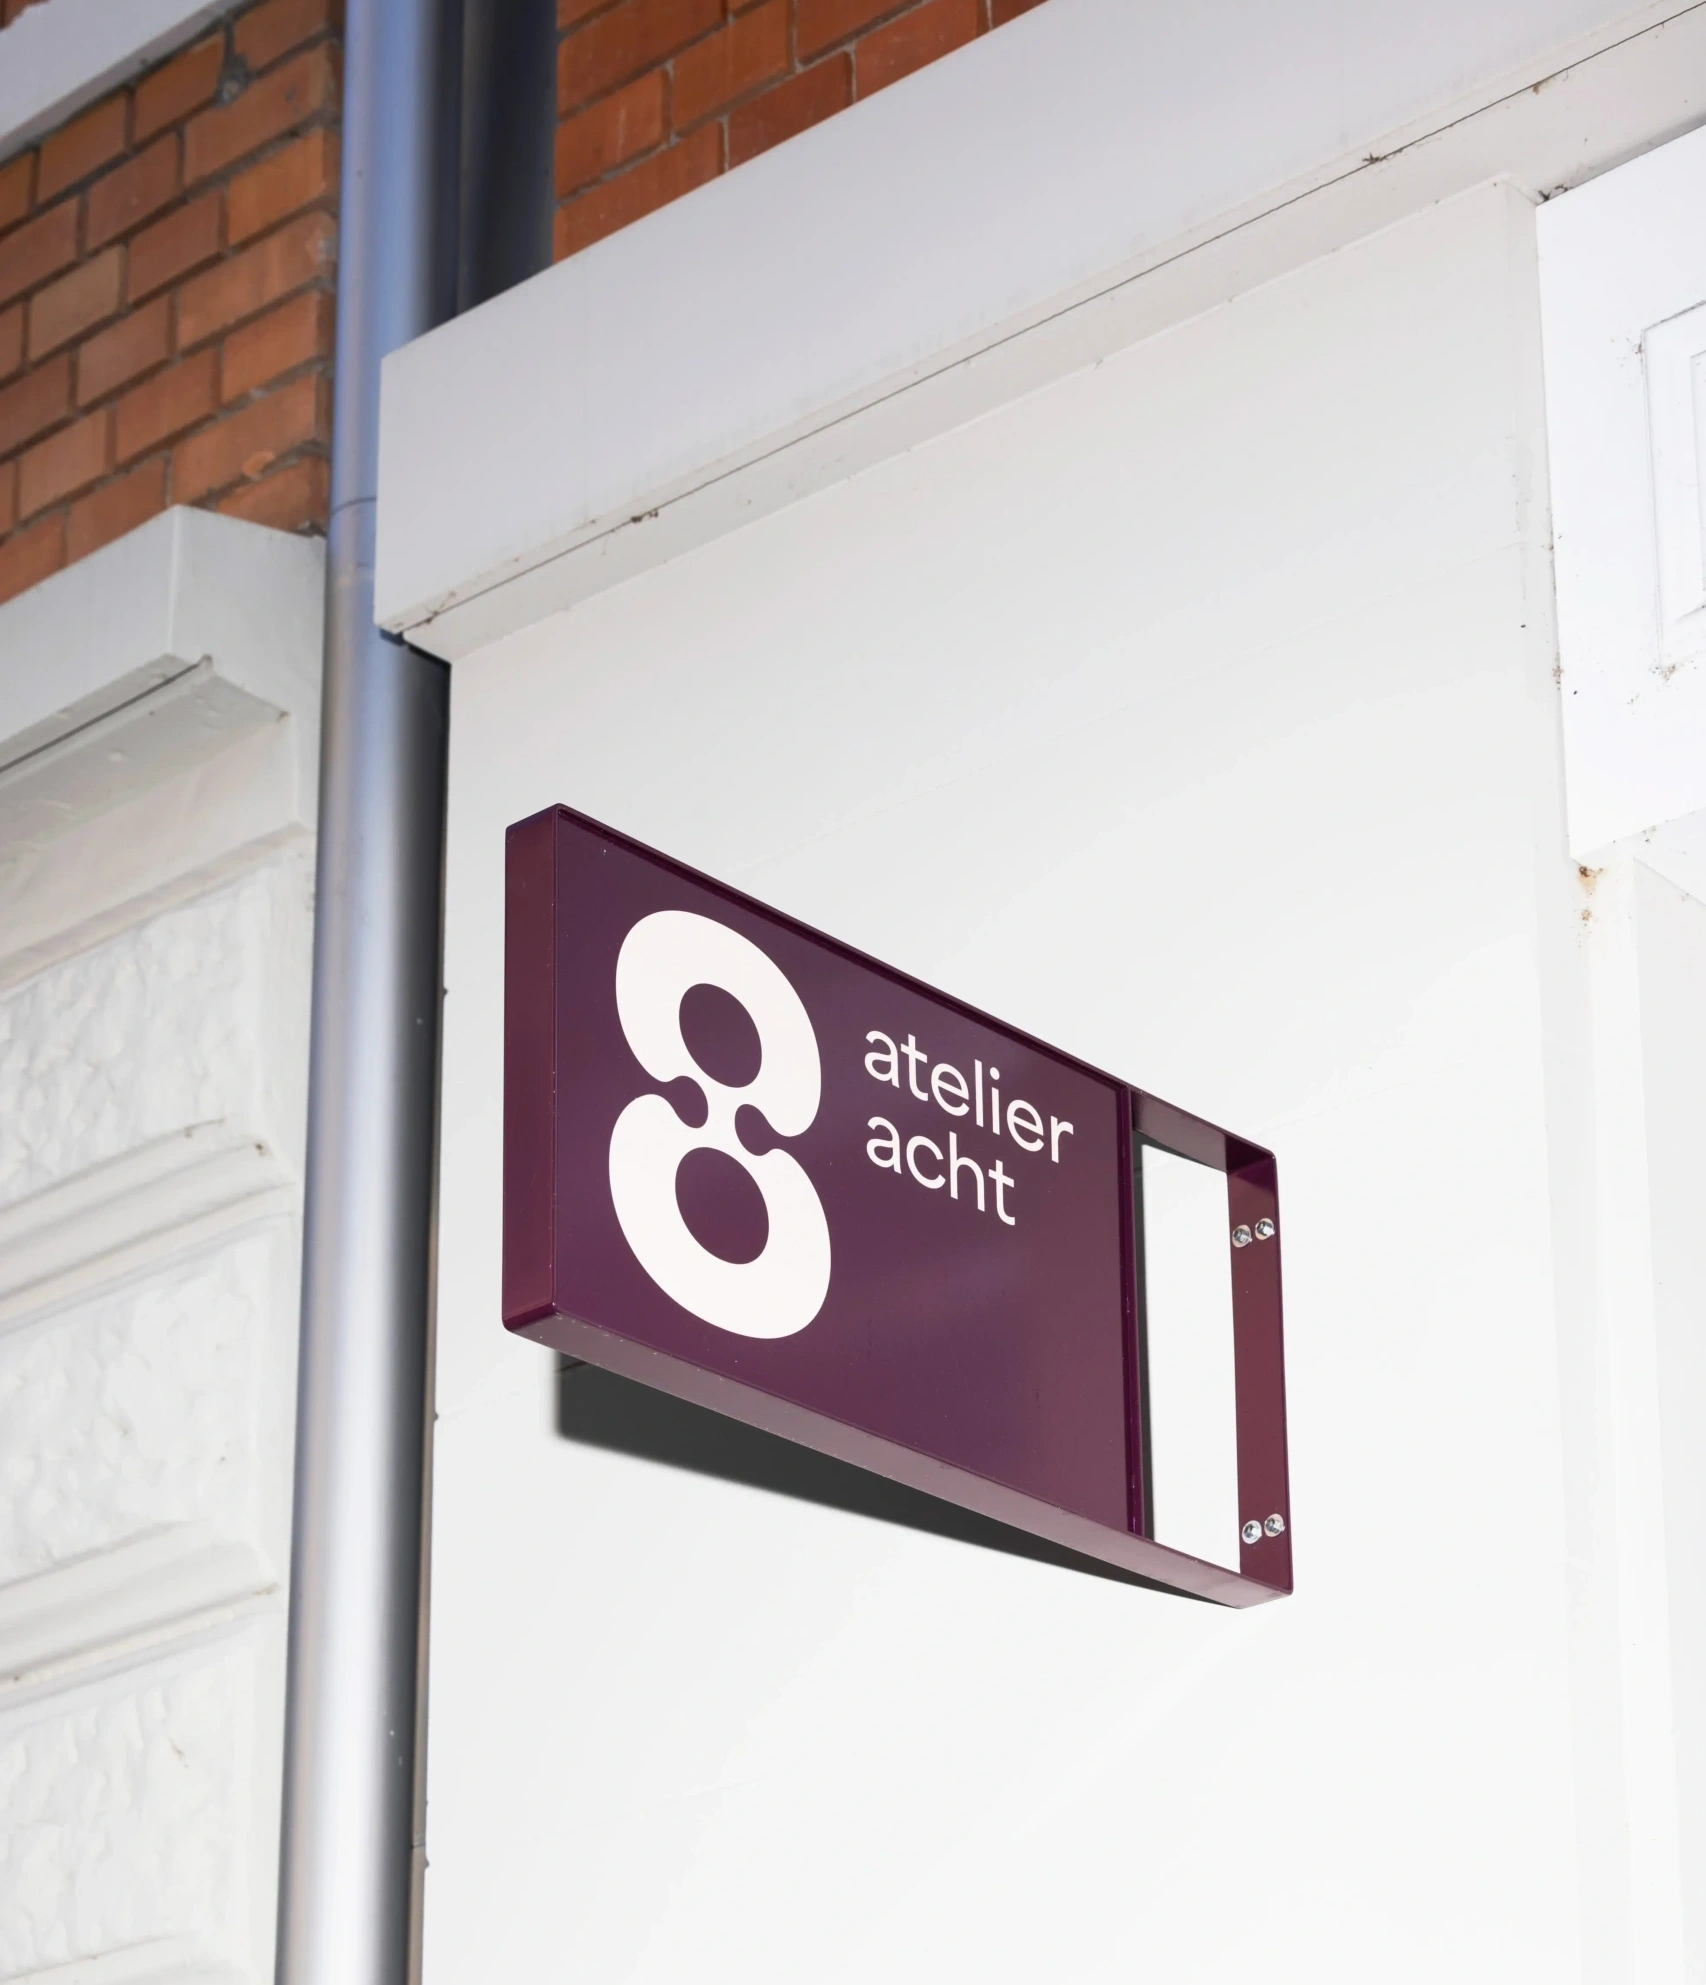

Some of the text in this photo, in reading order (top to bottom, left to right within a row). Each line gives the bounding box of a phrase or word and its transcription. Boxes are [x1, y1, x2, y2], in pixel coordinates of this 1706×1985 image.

[608, 909, 832, 1340] 8
[864, 1030, 1075, 1164] atelier
[866, 1116, 1017, 1227] acht
